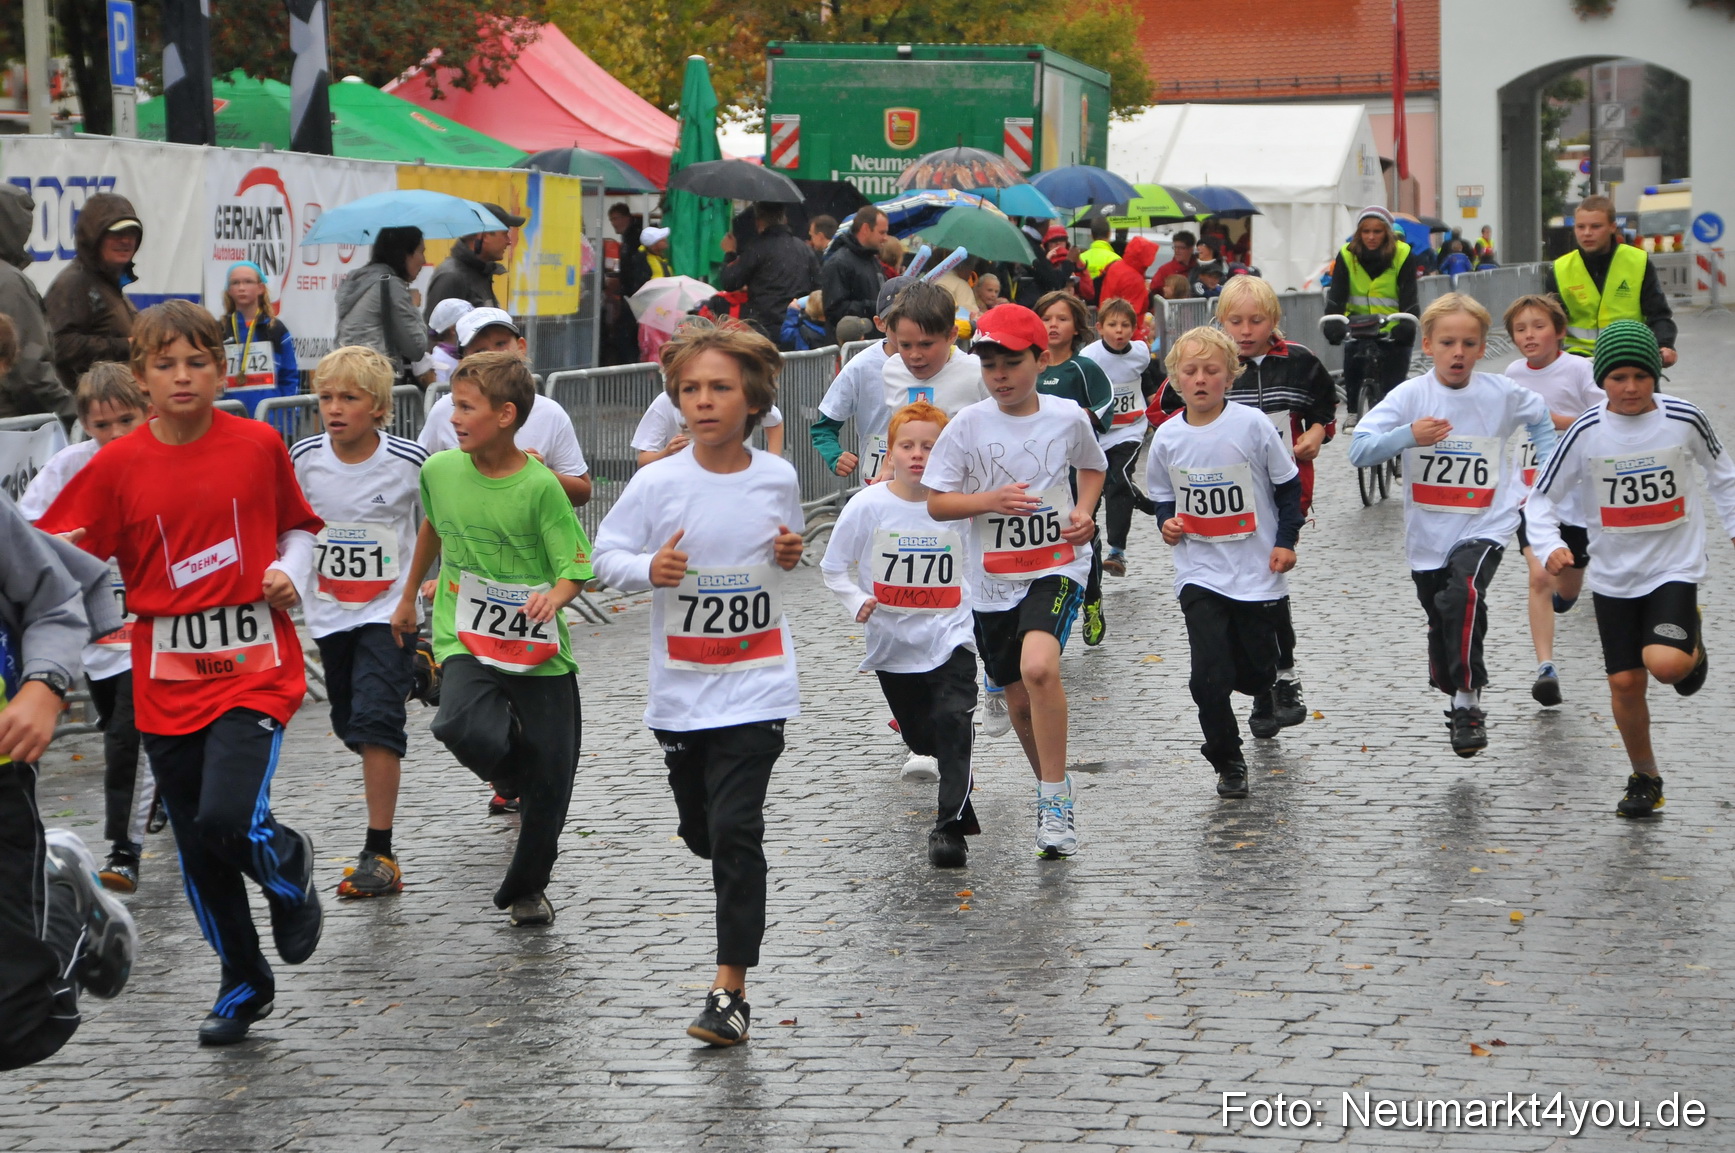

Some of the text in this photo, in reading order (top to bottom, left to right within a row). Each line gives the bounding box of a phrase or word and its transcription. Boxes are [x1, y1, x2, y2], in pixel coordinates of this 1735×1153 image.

[113, 11, 129, 74] P
[851, 154, 919, 171] Neuma
[214, 205, 283, 240] GERHART
[212, 243, 246, 261] Autohaus
[297, 276, 326, 290] SEAT
[228, 355, 268, 374] 742
[1114, 394, 1135, 413] 281
[1435, 441, 1472, 449] BOCK
[1420, 455, 1488, 485] 7276
[1615, 457, 1655, 470] BOCK
[1603, 470, 1676, 504] 7353
[1180, 486, 1244, 515] 7300
[327, 528, 366, 539] BOCK
[988, 512, 1060, 548] 7305
[899, 537, 937, 546] BOCK
[191, 553, 218, 573] DEHN
[318, 545, 383, 577] 7351
[882, 553, 953, 584] 7170
[1015, 556, 1041, 567] Marc
[698, 574, 749, 586] BOCK
[487, 587, 530, 601] BOCK
[882, 586, 945, 606] SIMON
[470, 598, 548, 640] 7242
[678, 591, 770, 634] 7280
[171, 604, 257, 649] 7016
[195, 658, 234, 674] Nico
